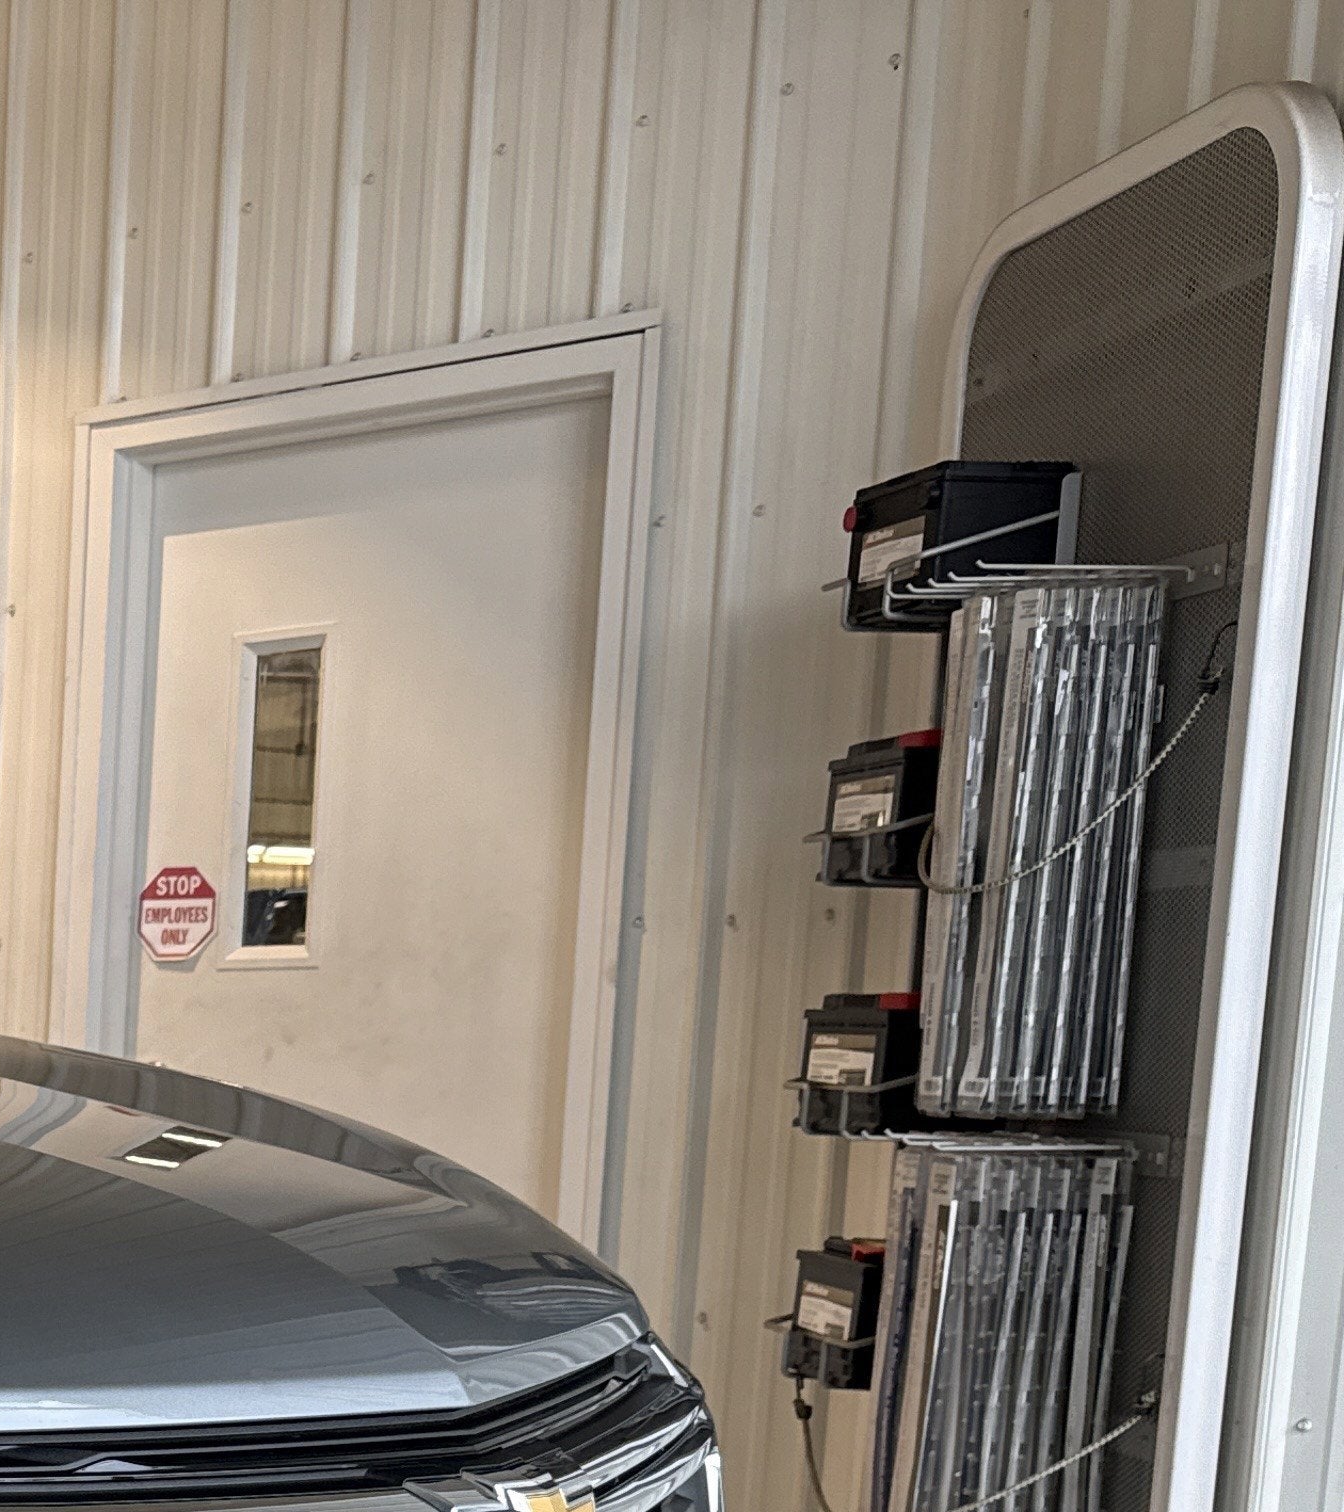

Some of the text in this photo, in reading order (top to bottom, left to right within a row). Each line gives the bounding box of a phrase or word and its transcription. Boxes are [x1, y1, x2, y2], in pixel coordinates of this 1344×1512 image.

[155, 874, 202, 896] STOP
[144, 906, 208, 924] EMPLOYEES
[160, 928, 190, 945] ONLY
